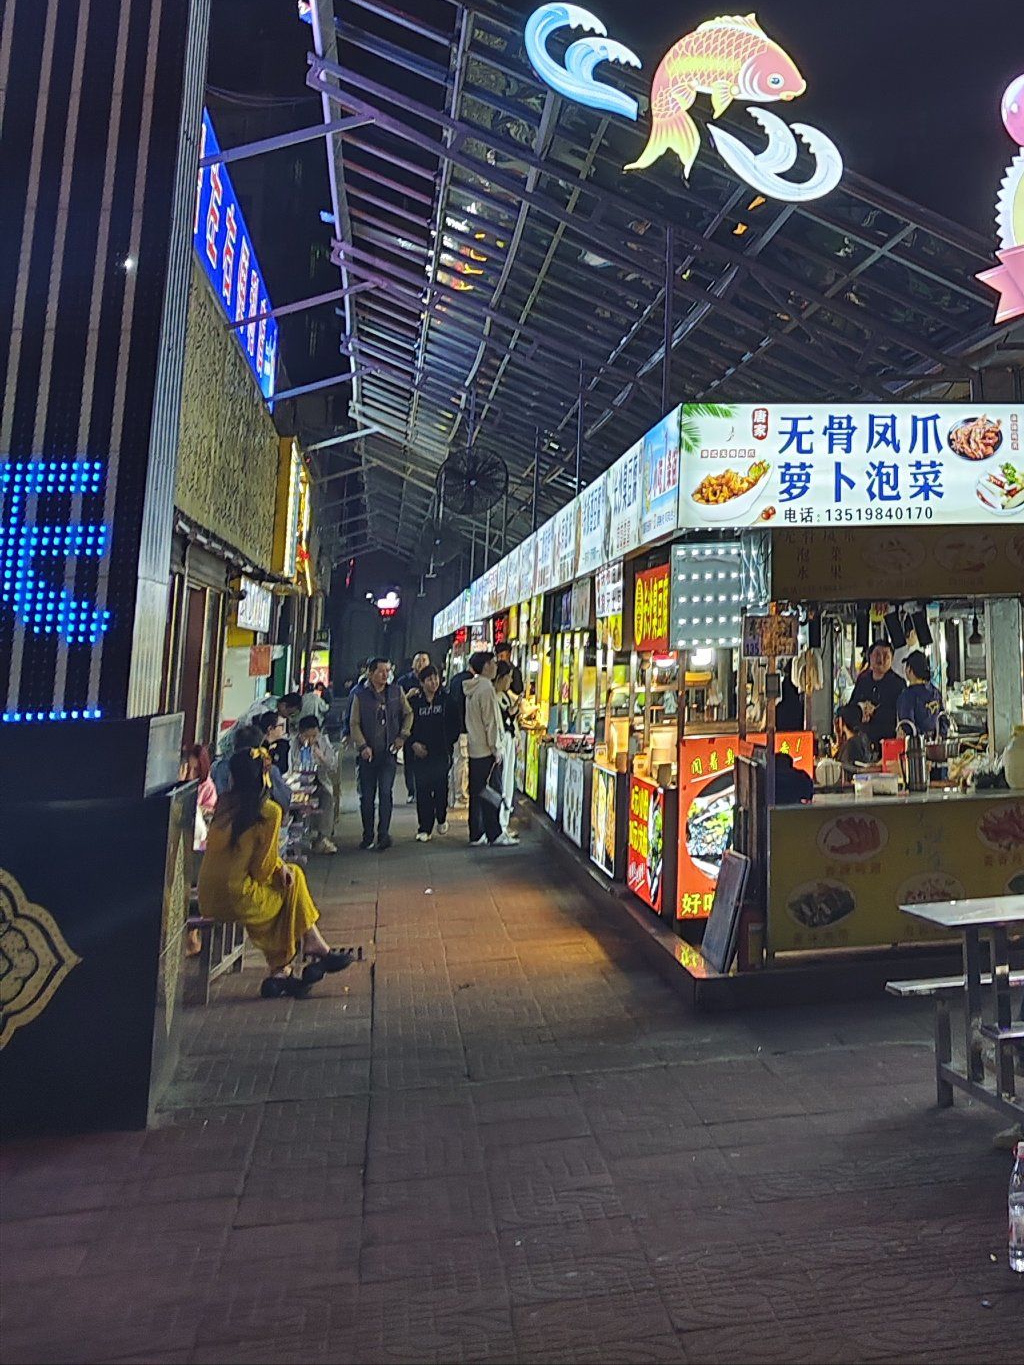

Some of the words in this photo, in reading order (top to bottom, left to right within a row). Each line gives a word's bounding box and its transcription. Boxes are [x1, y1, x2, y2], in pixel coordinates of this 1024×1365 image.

[752, 409, 768, 437] 唐家
[778, 414, 944, 454] 无骨凤爪
[778, 460, 945, 503] 萝卜泡菜
